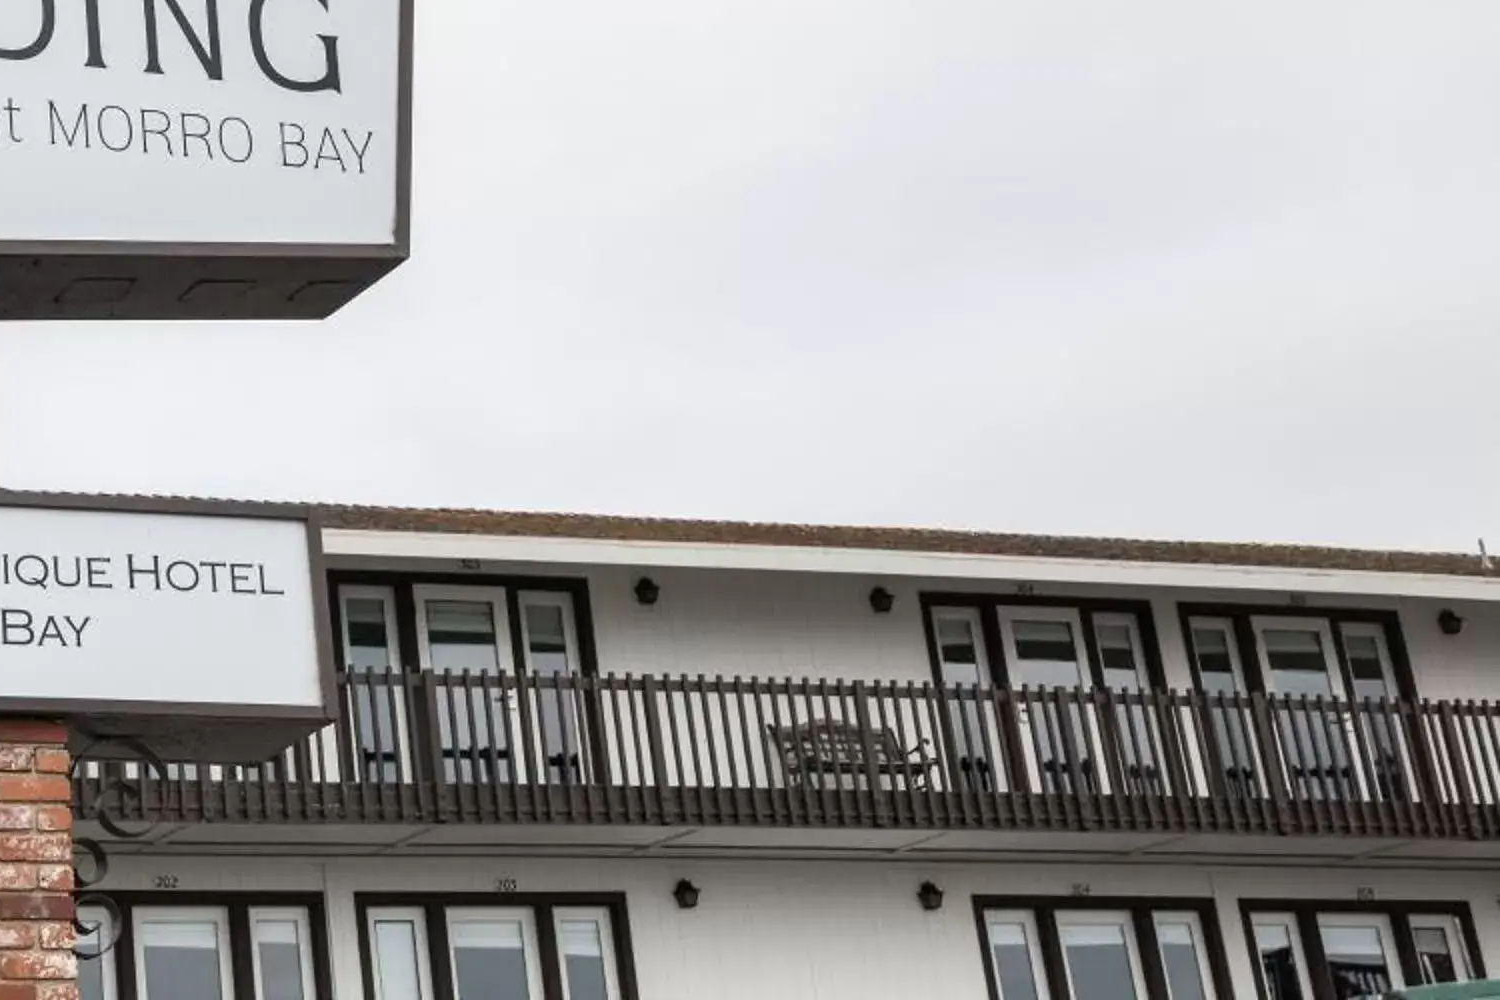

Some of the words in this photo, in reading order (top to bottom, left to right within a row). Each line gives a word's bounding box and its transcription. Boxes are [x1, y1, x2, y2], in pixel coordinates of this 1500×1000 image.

[47, 99, 254, 164] MORRO
[278, 121, 374, 175] BAY
[126, 553, 285, 596] HOTEL
[0, 607, 92, 648] BAY
